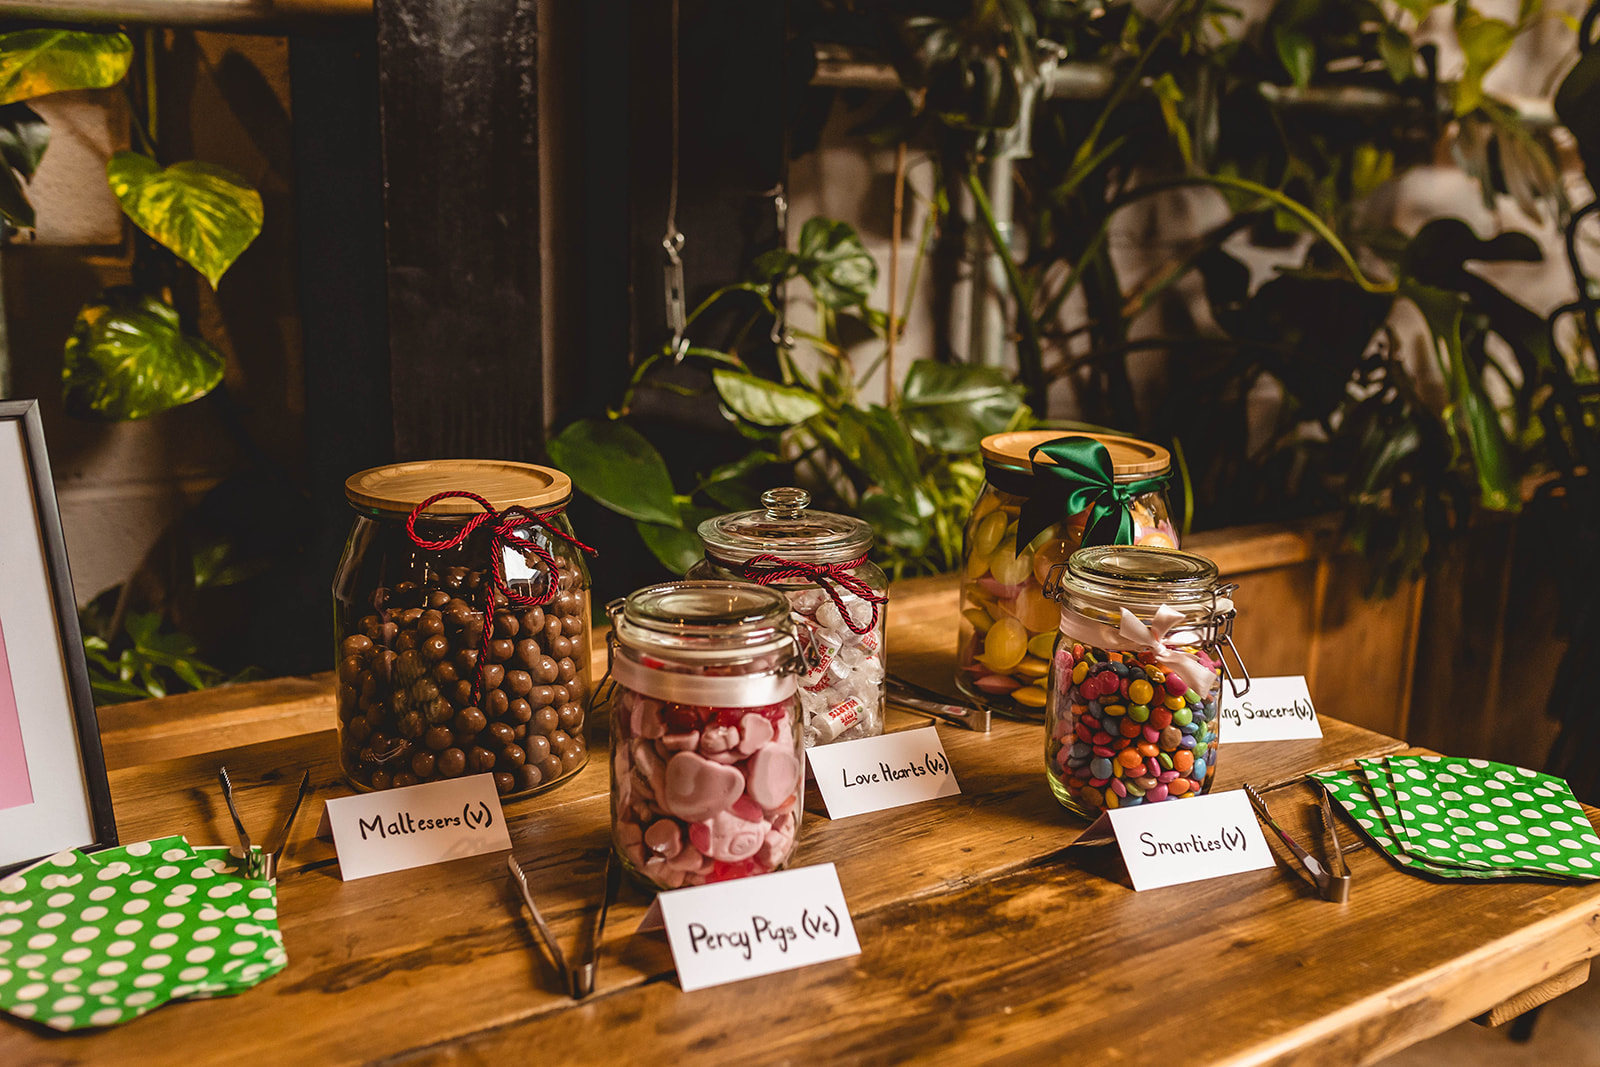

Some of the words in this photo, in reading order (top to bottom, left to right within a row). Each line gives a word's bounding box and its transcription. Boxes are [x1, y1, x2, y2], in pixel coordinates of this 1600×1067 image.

[842, 768, 880, 788] Love
[688, 922, 752, 960] Percy
[752, 915, 797, 954] Pigs
